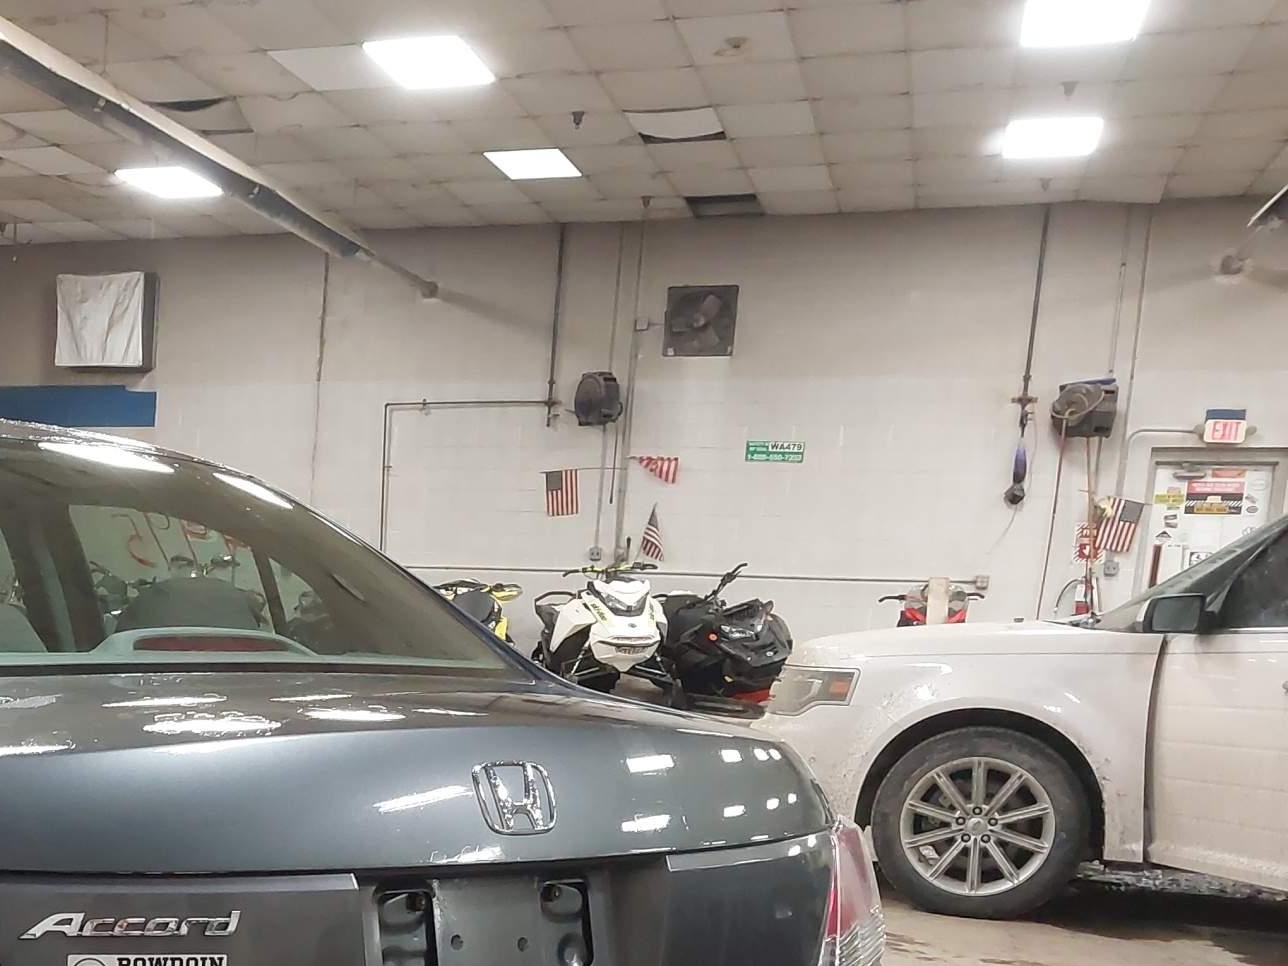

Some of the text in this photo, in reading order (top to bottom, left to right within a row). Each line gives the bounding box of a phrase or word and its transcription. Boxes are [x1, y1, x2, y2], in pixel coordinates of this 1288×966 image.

[1212, 420, 1242, 441] EXIT
[770, 443, 803, 451] WA479
[18, 910, 241, 939] Accord
